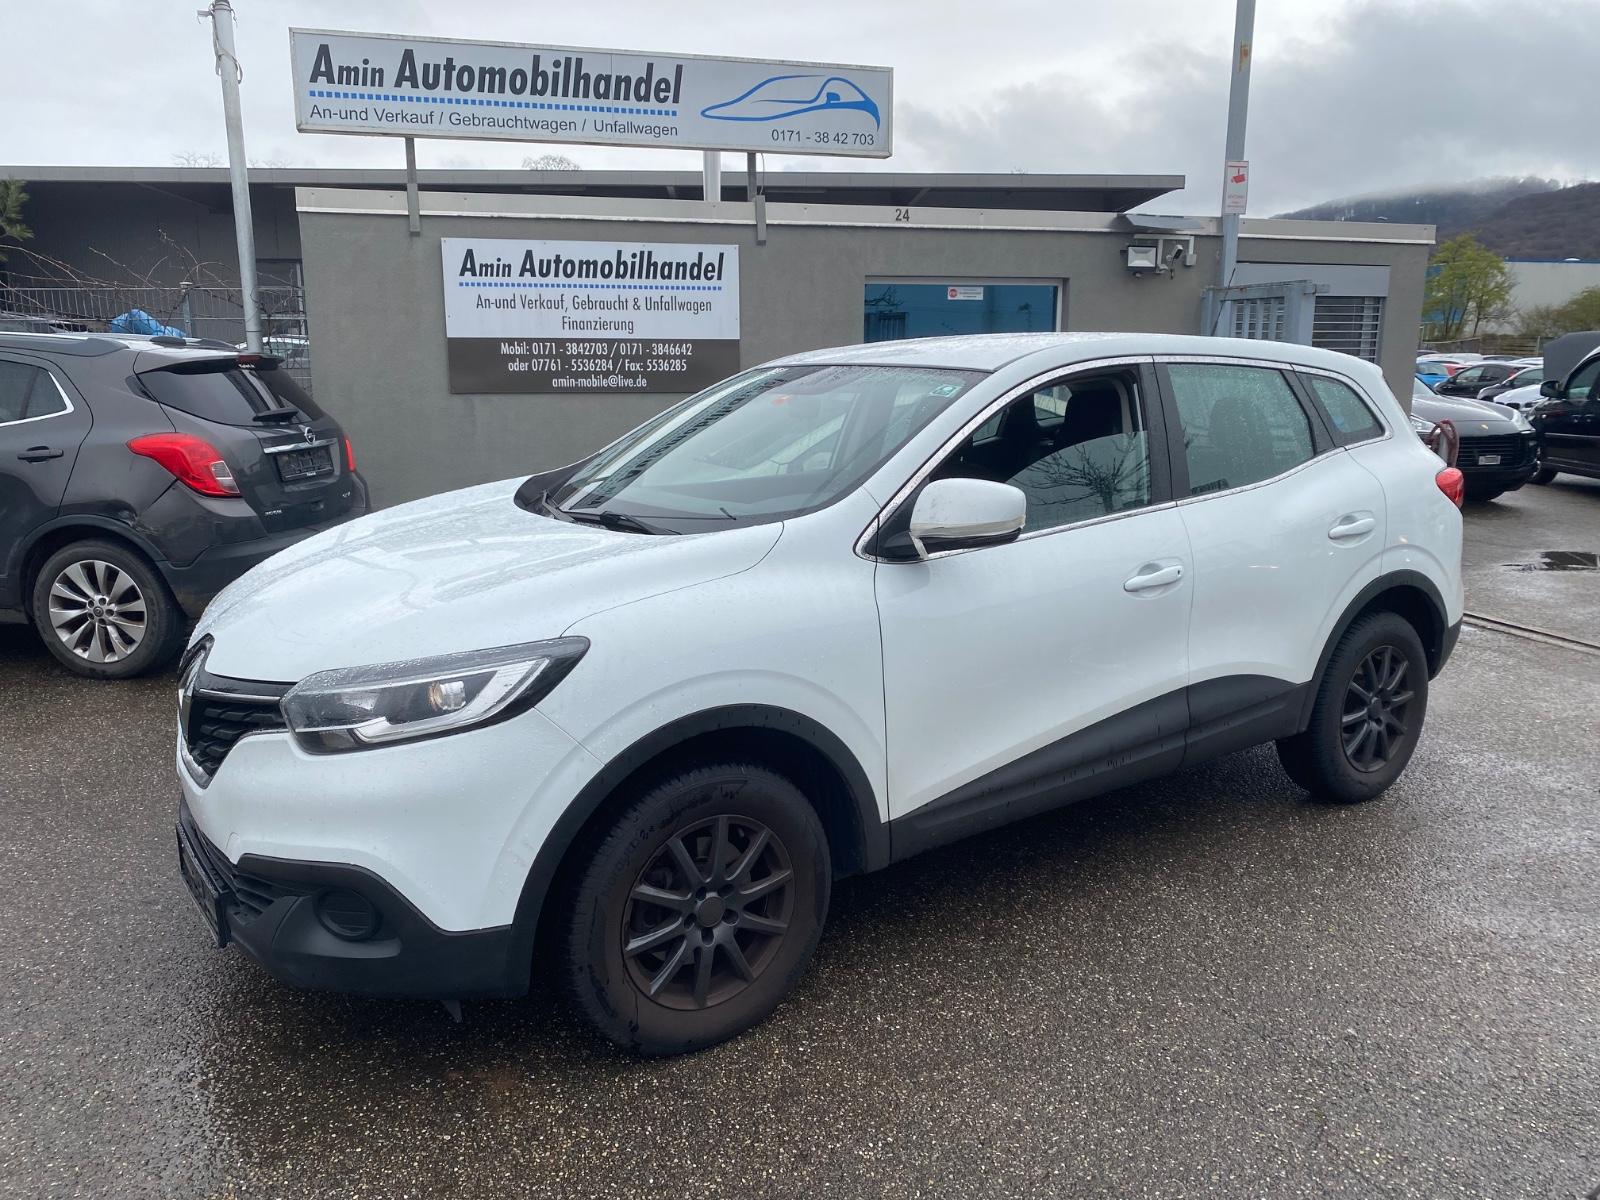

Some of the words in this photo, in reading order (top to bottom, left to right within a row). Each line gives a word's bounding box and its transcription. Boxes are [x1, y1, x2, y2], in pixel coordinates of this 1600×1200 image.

[309, 44, 384, 87] Amin
[394, 49, 683, 103] Automobilhandel
[310, 104, 369, 121] An-und
[374, 108, 434, 125] Verkauf
[439, 111, 444, 125] /
[449, 112, 577, 132] Gebrauchtwagen
[581, 118, 586, 132] /
[594, 119, 678, 138] Unfallwagen
[771, 129, 802, 142] 0171
[814, 132, 830, 144] 38
[833, 132, 848, 144] 42
[852, 133, 874, 145] 703
[895, 208, 910, 221] 24
[459, 249, 512, 278] Amin
[519, 249, 724, 281] Automobilhandel
[476, 294, 516, 310] An-und
[520, 294, 568, 312] Verkauf,
[572, 295, 629, 311] Gebraucht
[633, 299, 641, 311] &
[645, 296, 712, 314] Unfallwagen
[562, 316, 634, 334] Finanzierung
[501, 342, 530, 355] Mobil:
[532, 342, 556, 355] 0171
[566, 343, 608, 355] 3842703
[610, 342, 617, 356] /
[620, 343, 643, 356] 0171
[652, 344, 692, 356] 3846642
[508, 359, 528, 371] oder
[531, 359, 561, 371] 07761
[571, 360, 613, 371] 5536284
[616, 359, 622, 372] /
[625, 360, 643, 371] Fax:
[646, 360, 687, 372] 5536285
[552, 375, 647, 388] amin-mobile@live.de
